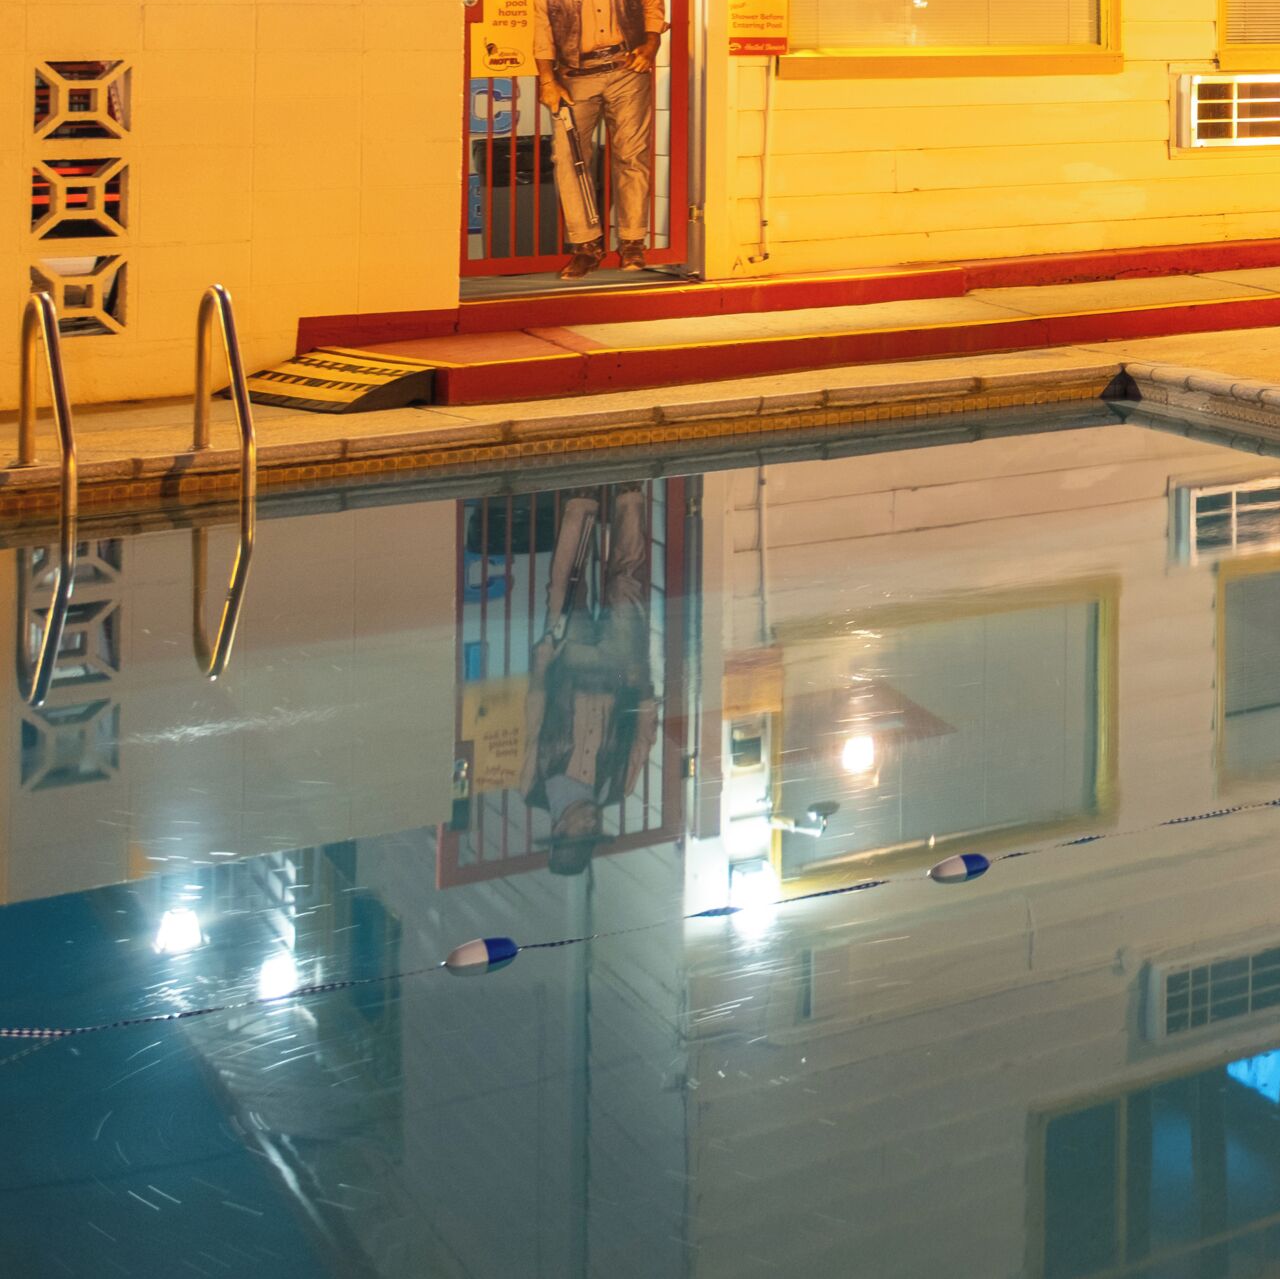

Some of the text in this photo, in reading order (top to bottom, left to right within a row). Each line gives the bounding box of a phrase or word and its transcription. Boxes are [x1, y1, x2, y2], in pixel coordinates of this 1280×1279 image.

[505, 0, 528, 8] pool
[498, 8, 528, 17] hours
[510, 19, 528, 28] 9-9
[489, 57, 521, 66] MOTEL
